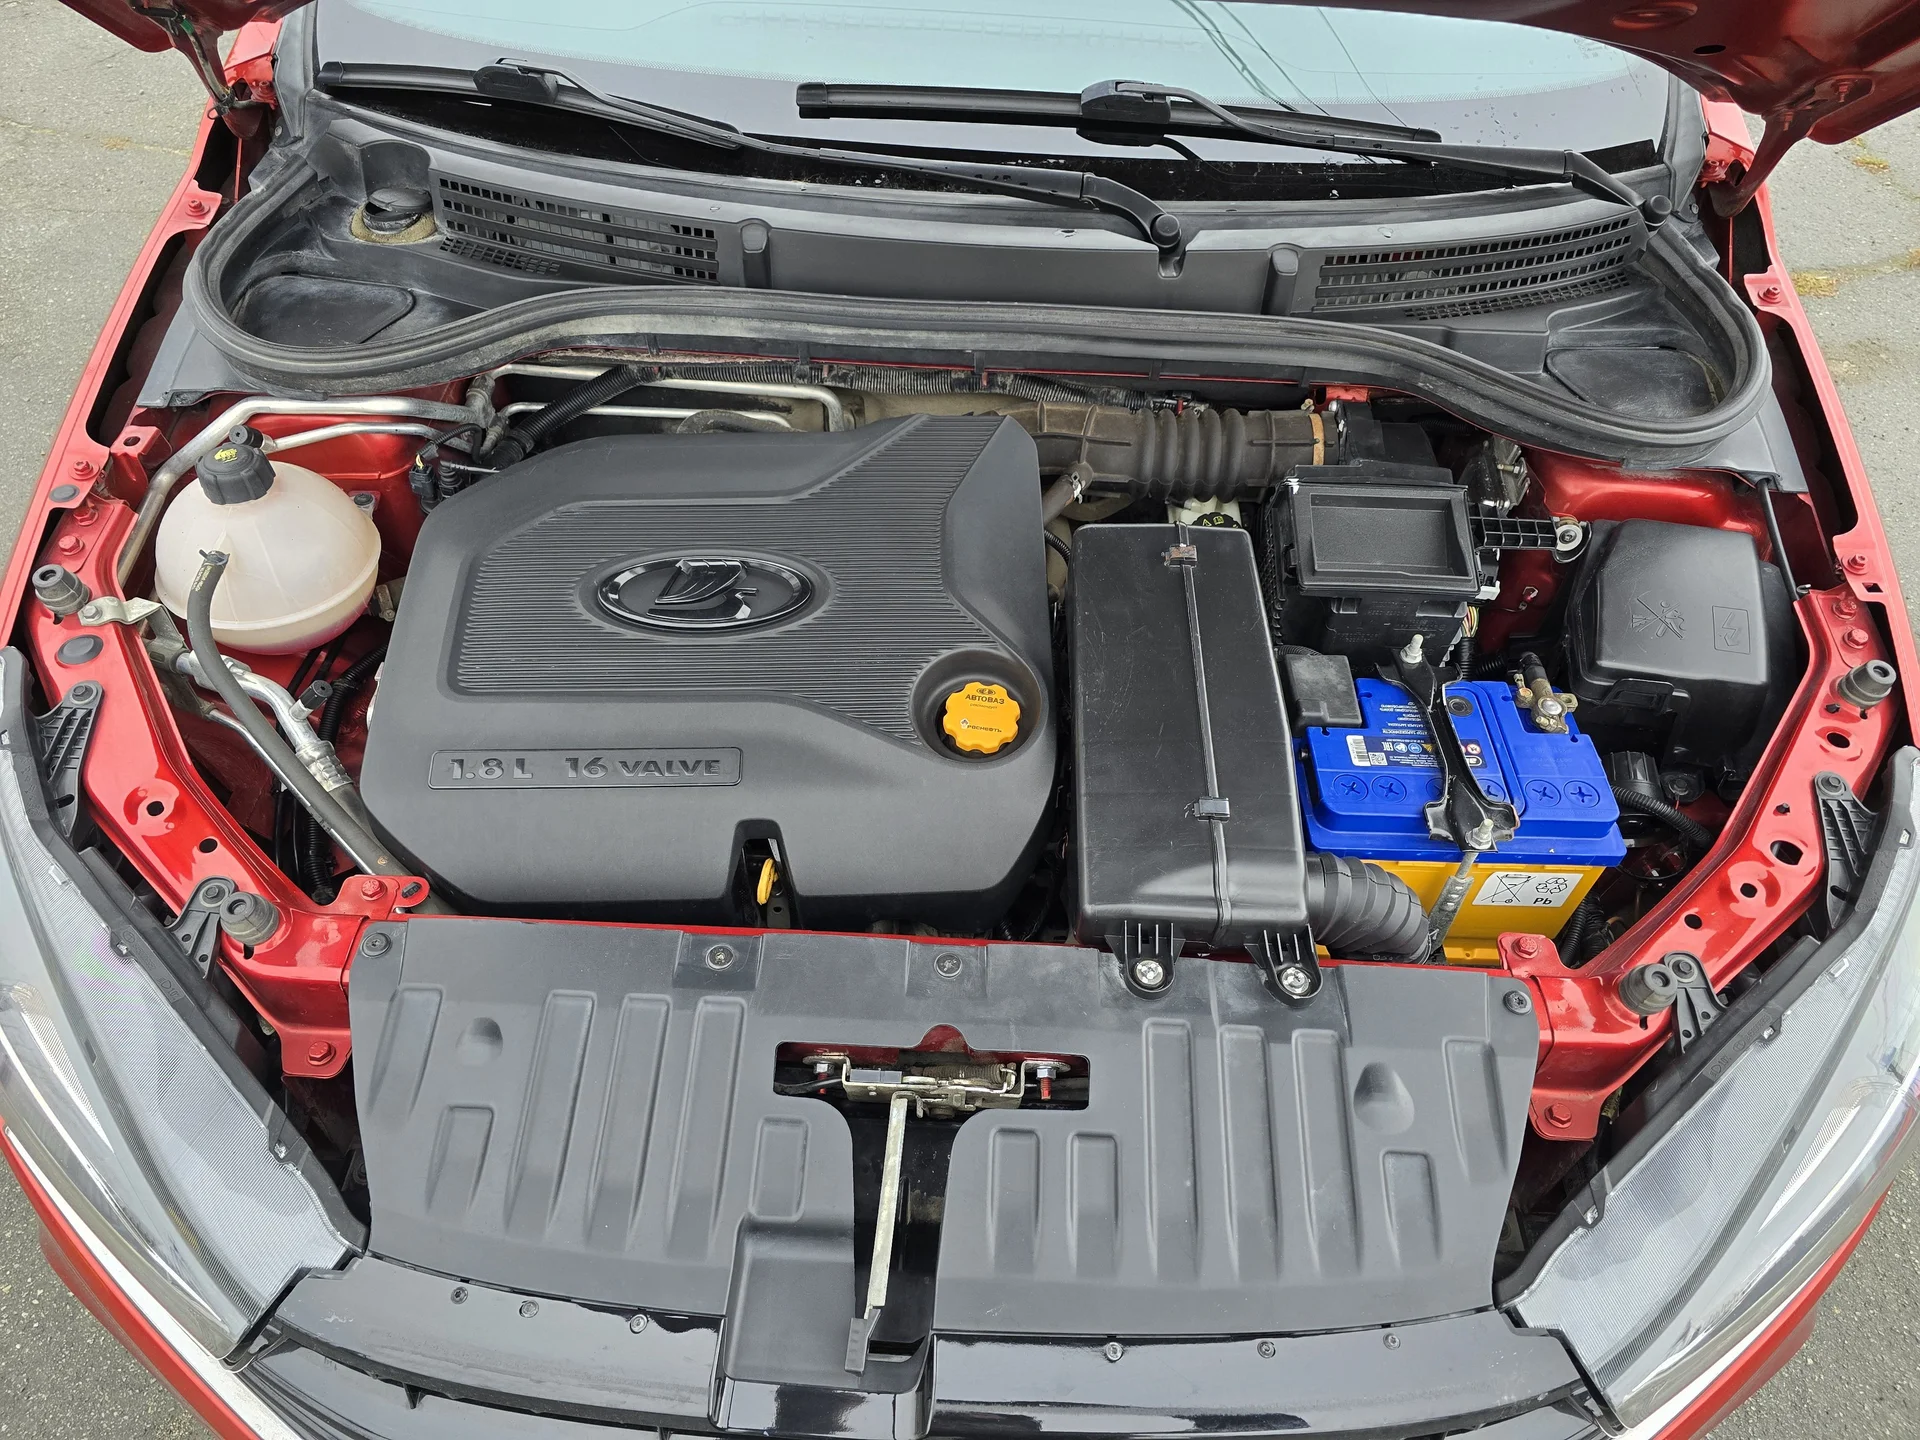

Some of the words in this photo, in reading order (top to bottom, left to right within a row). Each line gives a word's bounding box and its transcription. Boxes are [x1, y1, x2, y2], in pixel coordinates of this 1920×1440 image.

[965, 694, 1005, 704] АВТОВАЗ
[564, 756, 609, 780] 16
[617, 759, 721, 778] VALVE
[1533, 897, 1553, 905] Pb
